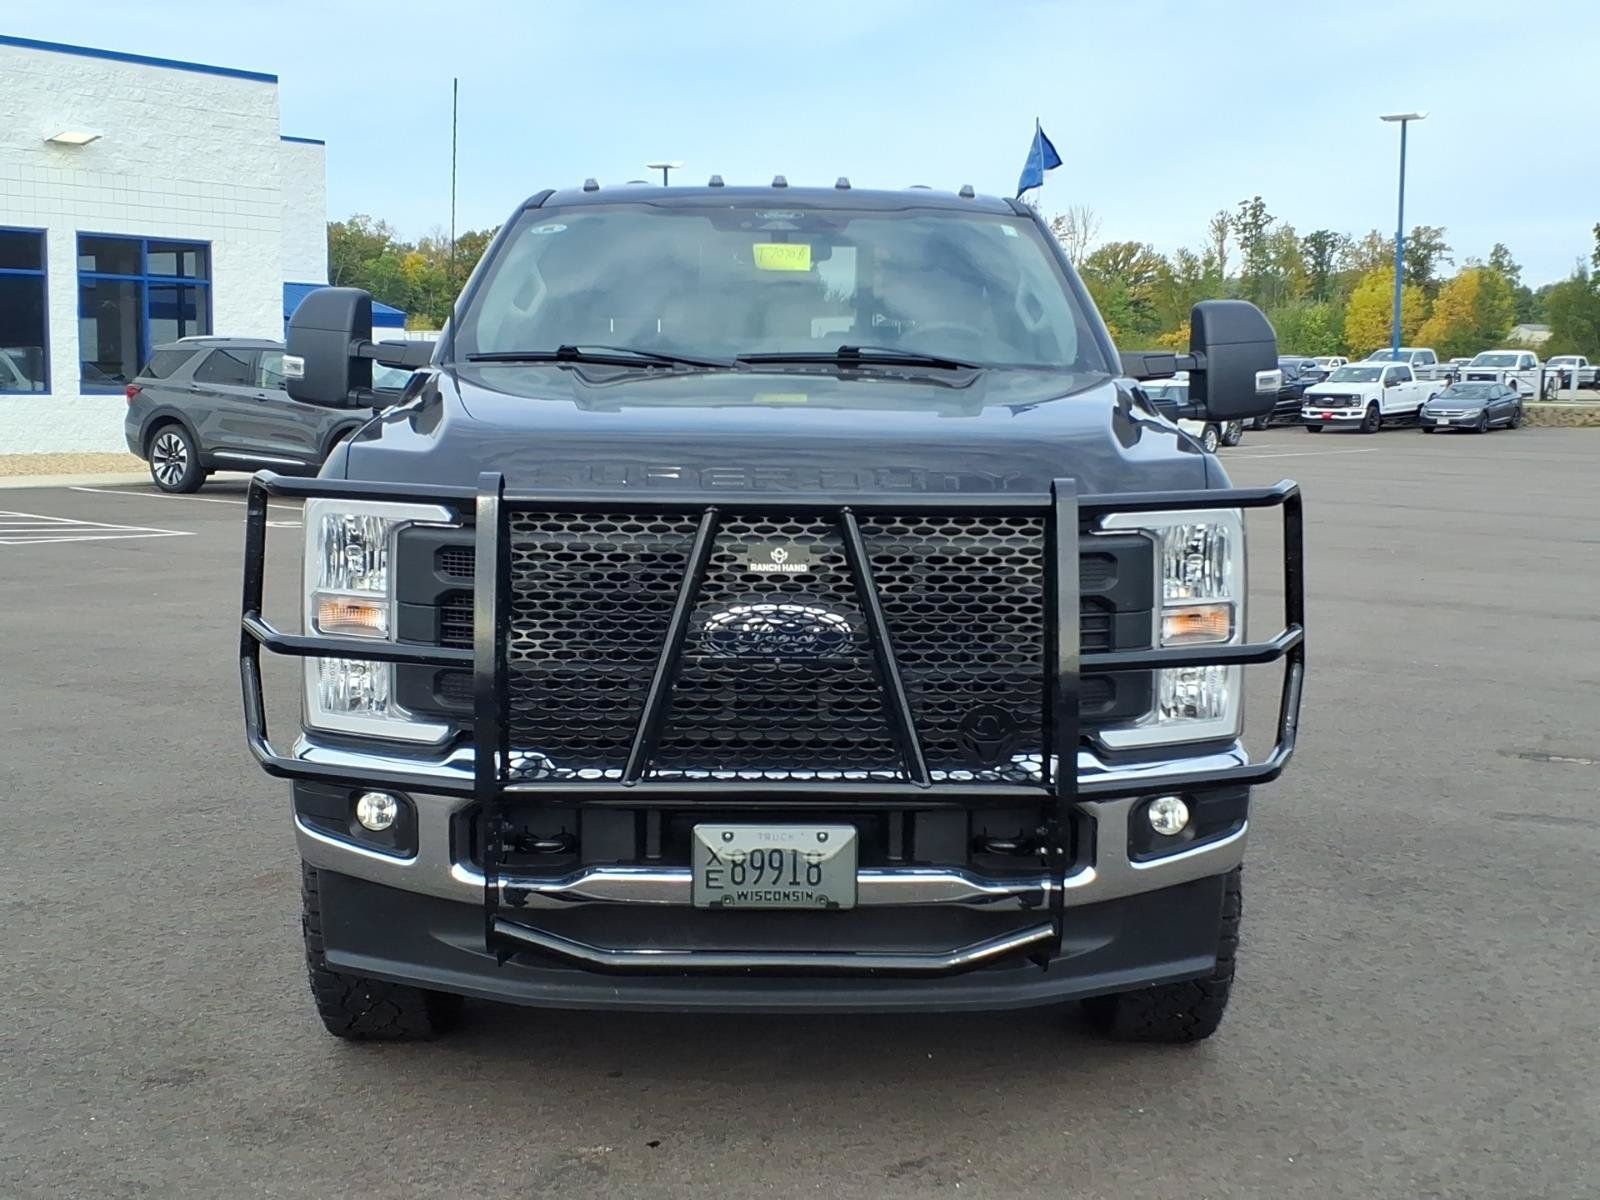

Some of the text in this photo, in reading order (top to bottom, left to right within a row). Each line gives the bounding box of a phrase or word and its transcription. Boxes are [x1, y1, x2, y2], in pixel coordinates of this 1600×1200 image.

[750, 563, 807, 572] RANCH HAND
[758, 832, 795, 842] TRUCK
[737, 891, 814, 902] WISCONSIN
